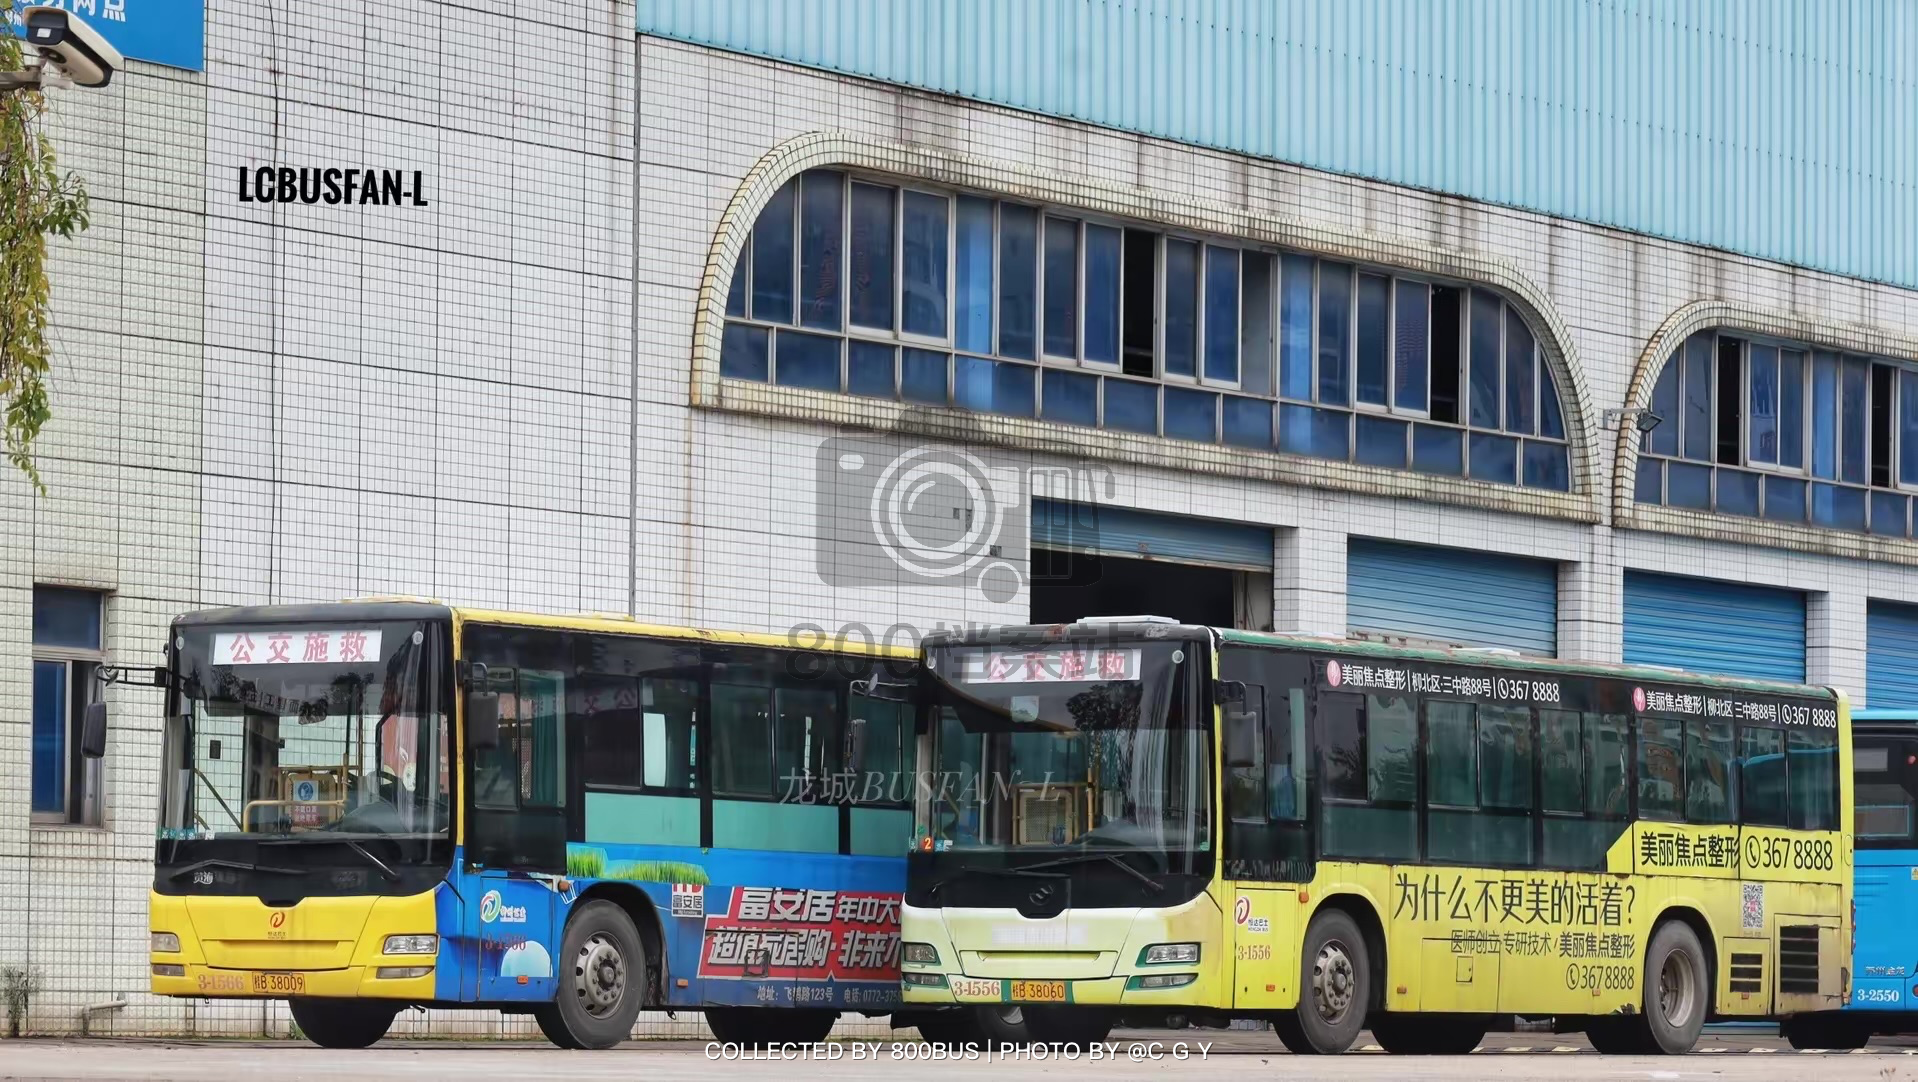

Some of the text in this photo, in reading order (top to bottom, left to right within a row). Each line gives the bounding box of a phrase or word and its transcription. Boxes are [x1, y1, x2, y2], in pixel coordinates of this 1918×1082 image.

[230, 631, 367, 664] 公交施救
[988, 652, 1125, 682] 公交施救
[1342, 664, 1405, 690] 美丽焦点整形
[1646, 691, 1702, 715] 美丽焦点整形
[924, 837, 932, 850] 2
[1641, 831, 1740, 869] 美丽焦点整形
[673, 895, 703, 909] 富安居
[738, 887, 837, 923] 富安居
[1394, 873, 1636, 927] 为什么不更美的活着?
[1238, 945, 1271, 960] 3-1556
[1559, 931, 1636, 960] 美丽焦点整形
[198, 974, 244, 990] 3-1566
[954, 981, 1000, 996] 3-1556
[1857, 989, 1900, 1002] 3-2550
